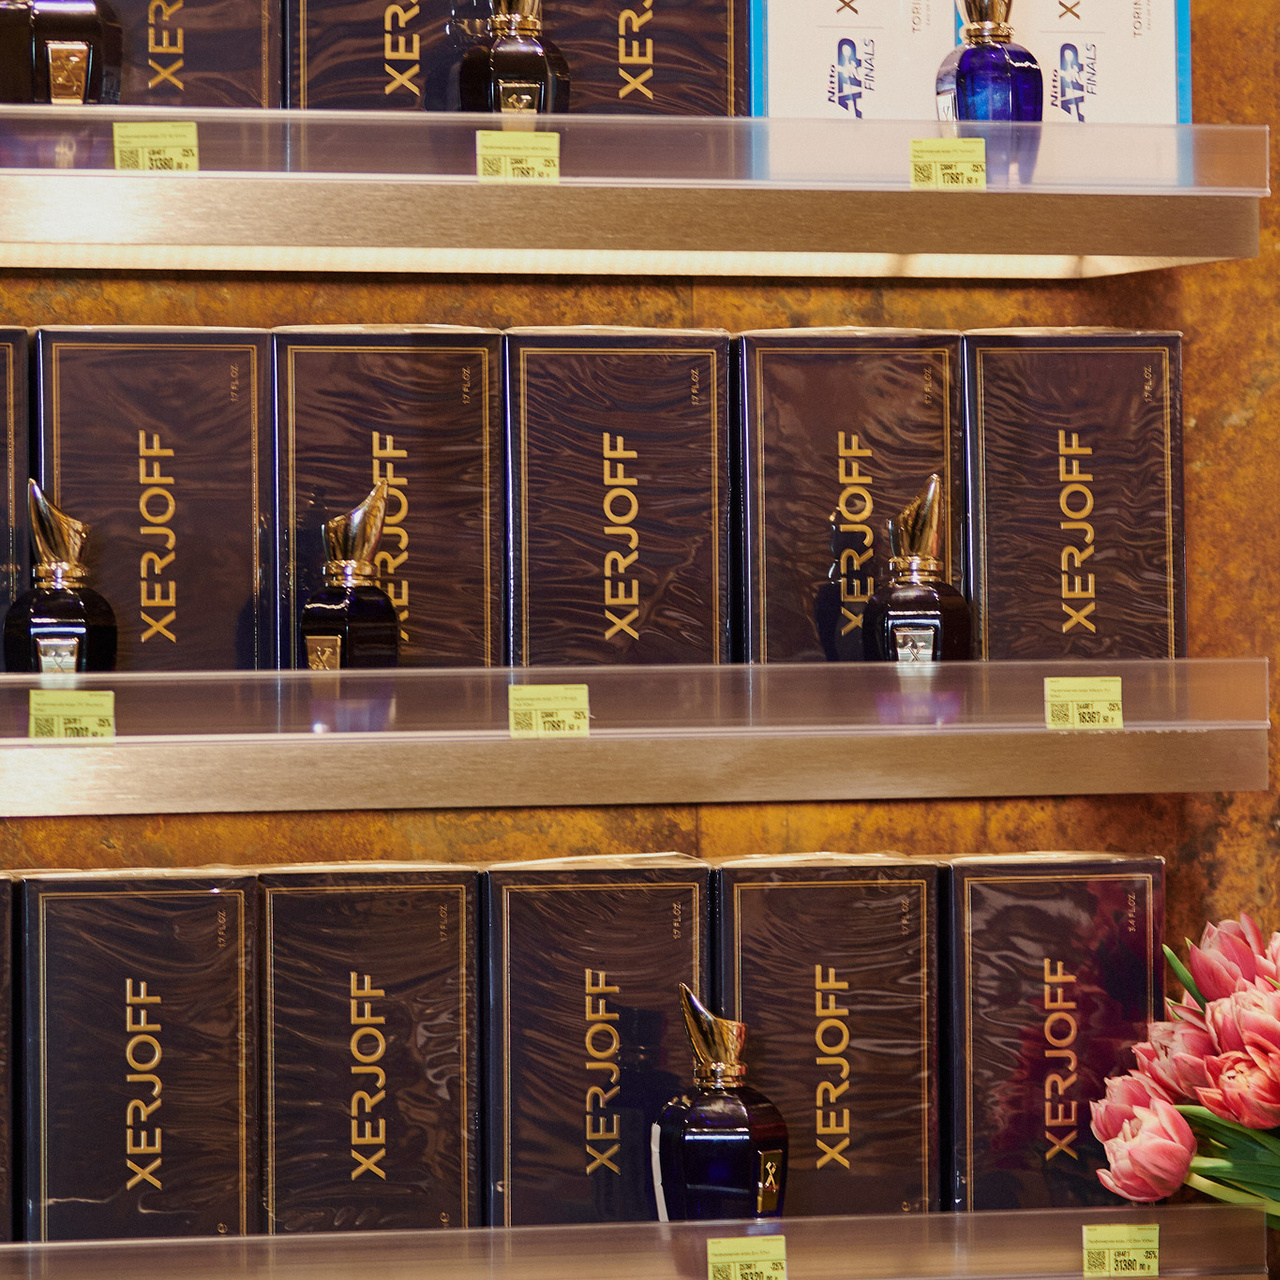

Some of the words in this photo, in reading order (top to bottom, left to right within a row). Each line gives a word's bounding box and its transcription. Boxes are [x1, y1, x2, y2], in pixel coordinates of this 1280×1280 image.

[863, 38, 876, 92] FINALS
[1086, 42, 1098, 96] FINALS
[139, 429, 177, 644] XERJOFF
[372, 430, 410, 643] ERJOFF
[603, 432, 642, 641] XERJOFF
[1058, 429, 1097, 634] XERJOFF
[126, 977, 163, 1191] XERJOFF
[350, 971, 387, 1181] XERJOFF
[585, 968, 622, 1176] XERJOFF
[815, 964, 850, 1170] XERJOFF
[1044, 957, 1079, 1161] XERJOFF
[1114, 1258, 1137, 1272] 31380
